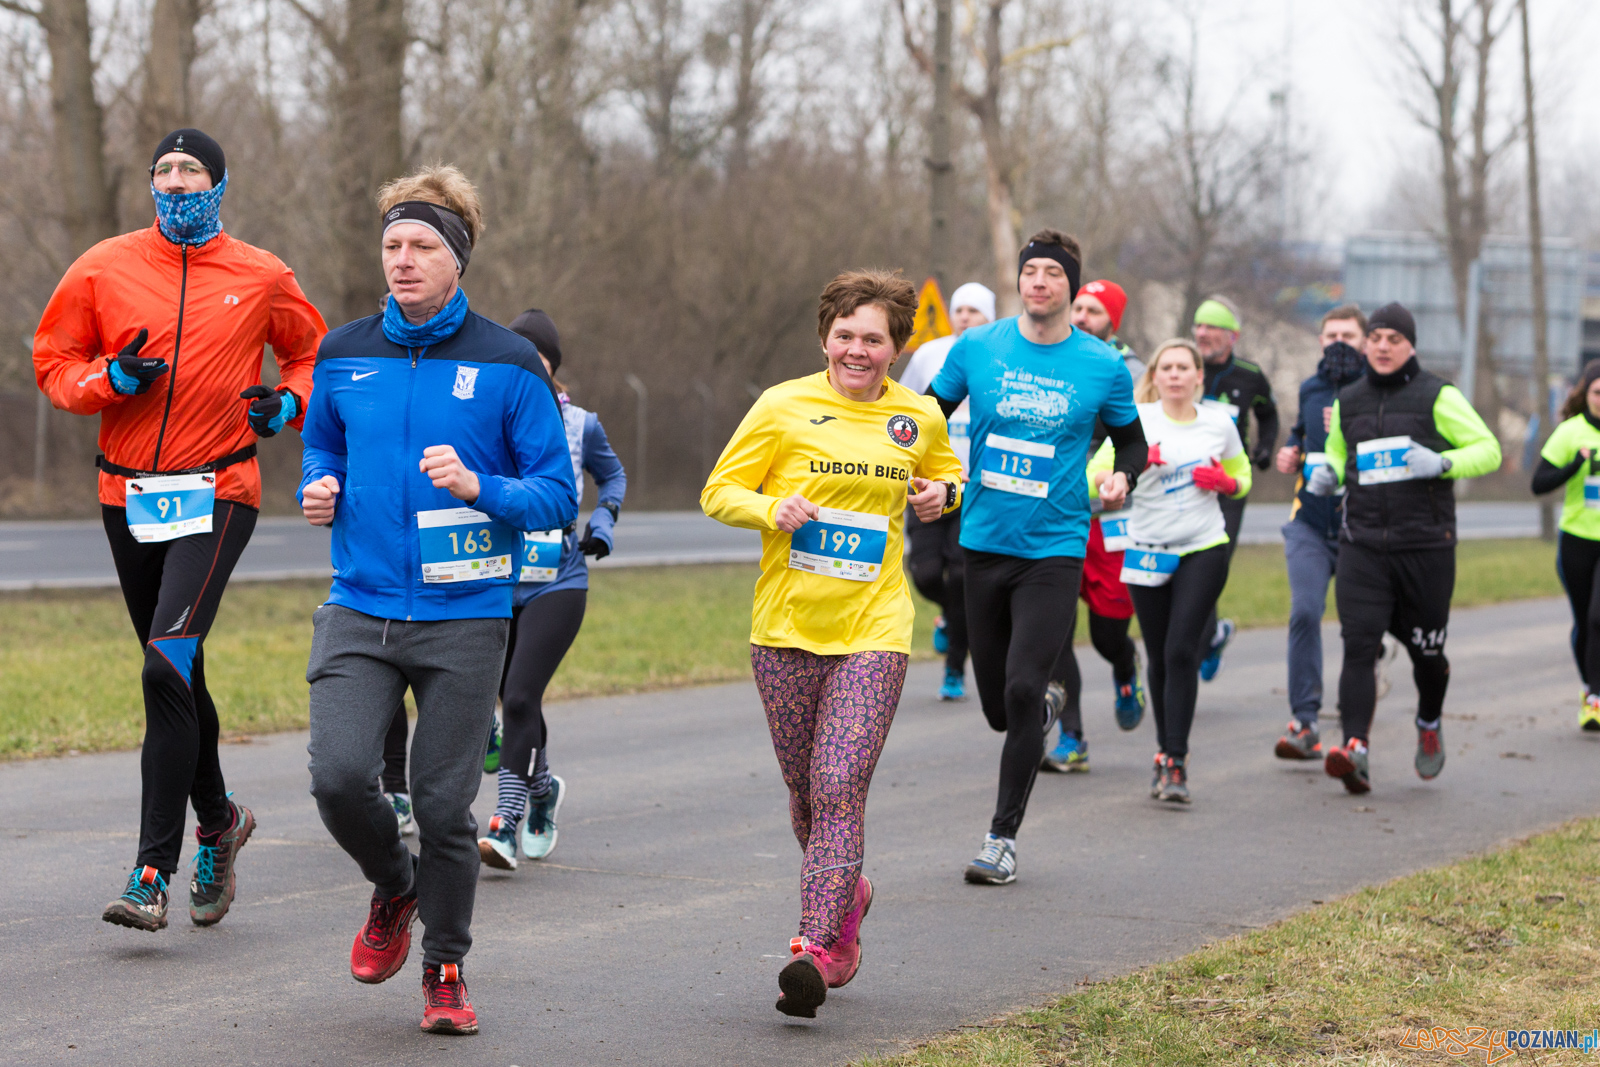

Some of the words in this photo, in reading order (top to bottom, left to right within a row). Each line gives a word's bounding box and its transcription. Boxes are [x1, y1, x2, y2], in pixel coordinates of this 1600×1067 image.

[810, 461, 869, 476] LUBOŃ
[1001, 454, 1032, 476] 113
[1373, 451, 1393, 468] 25
[157, 496, 182, 519] 91
[448, 529, 493, 555] 163
[819, 528, 861, 555] 199
[1139, 553, 1158, 571] 46
[1411, 626, 1445, 649] 3,14
